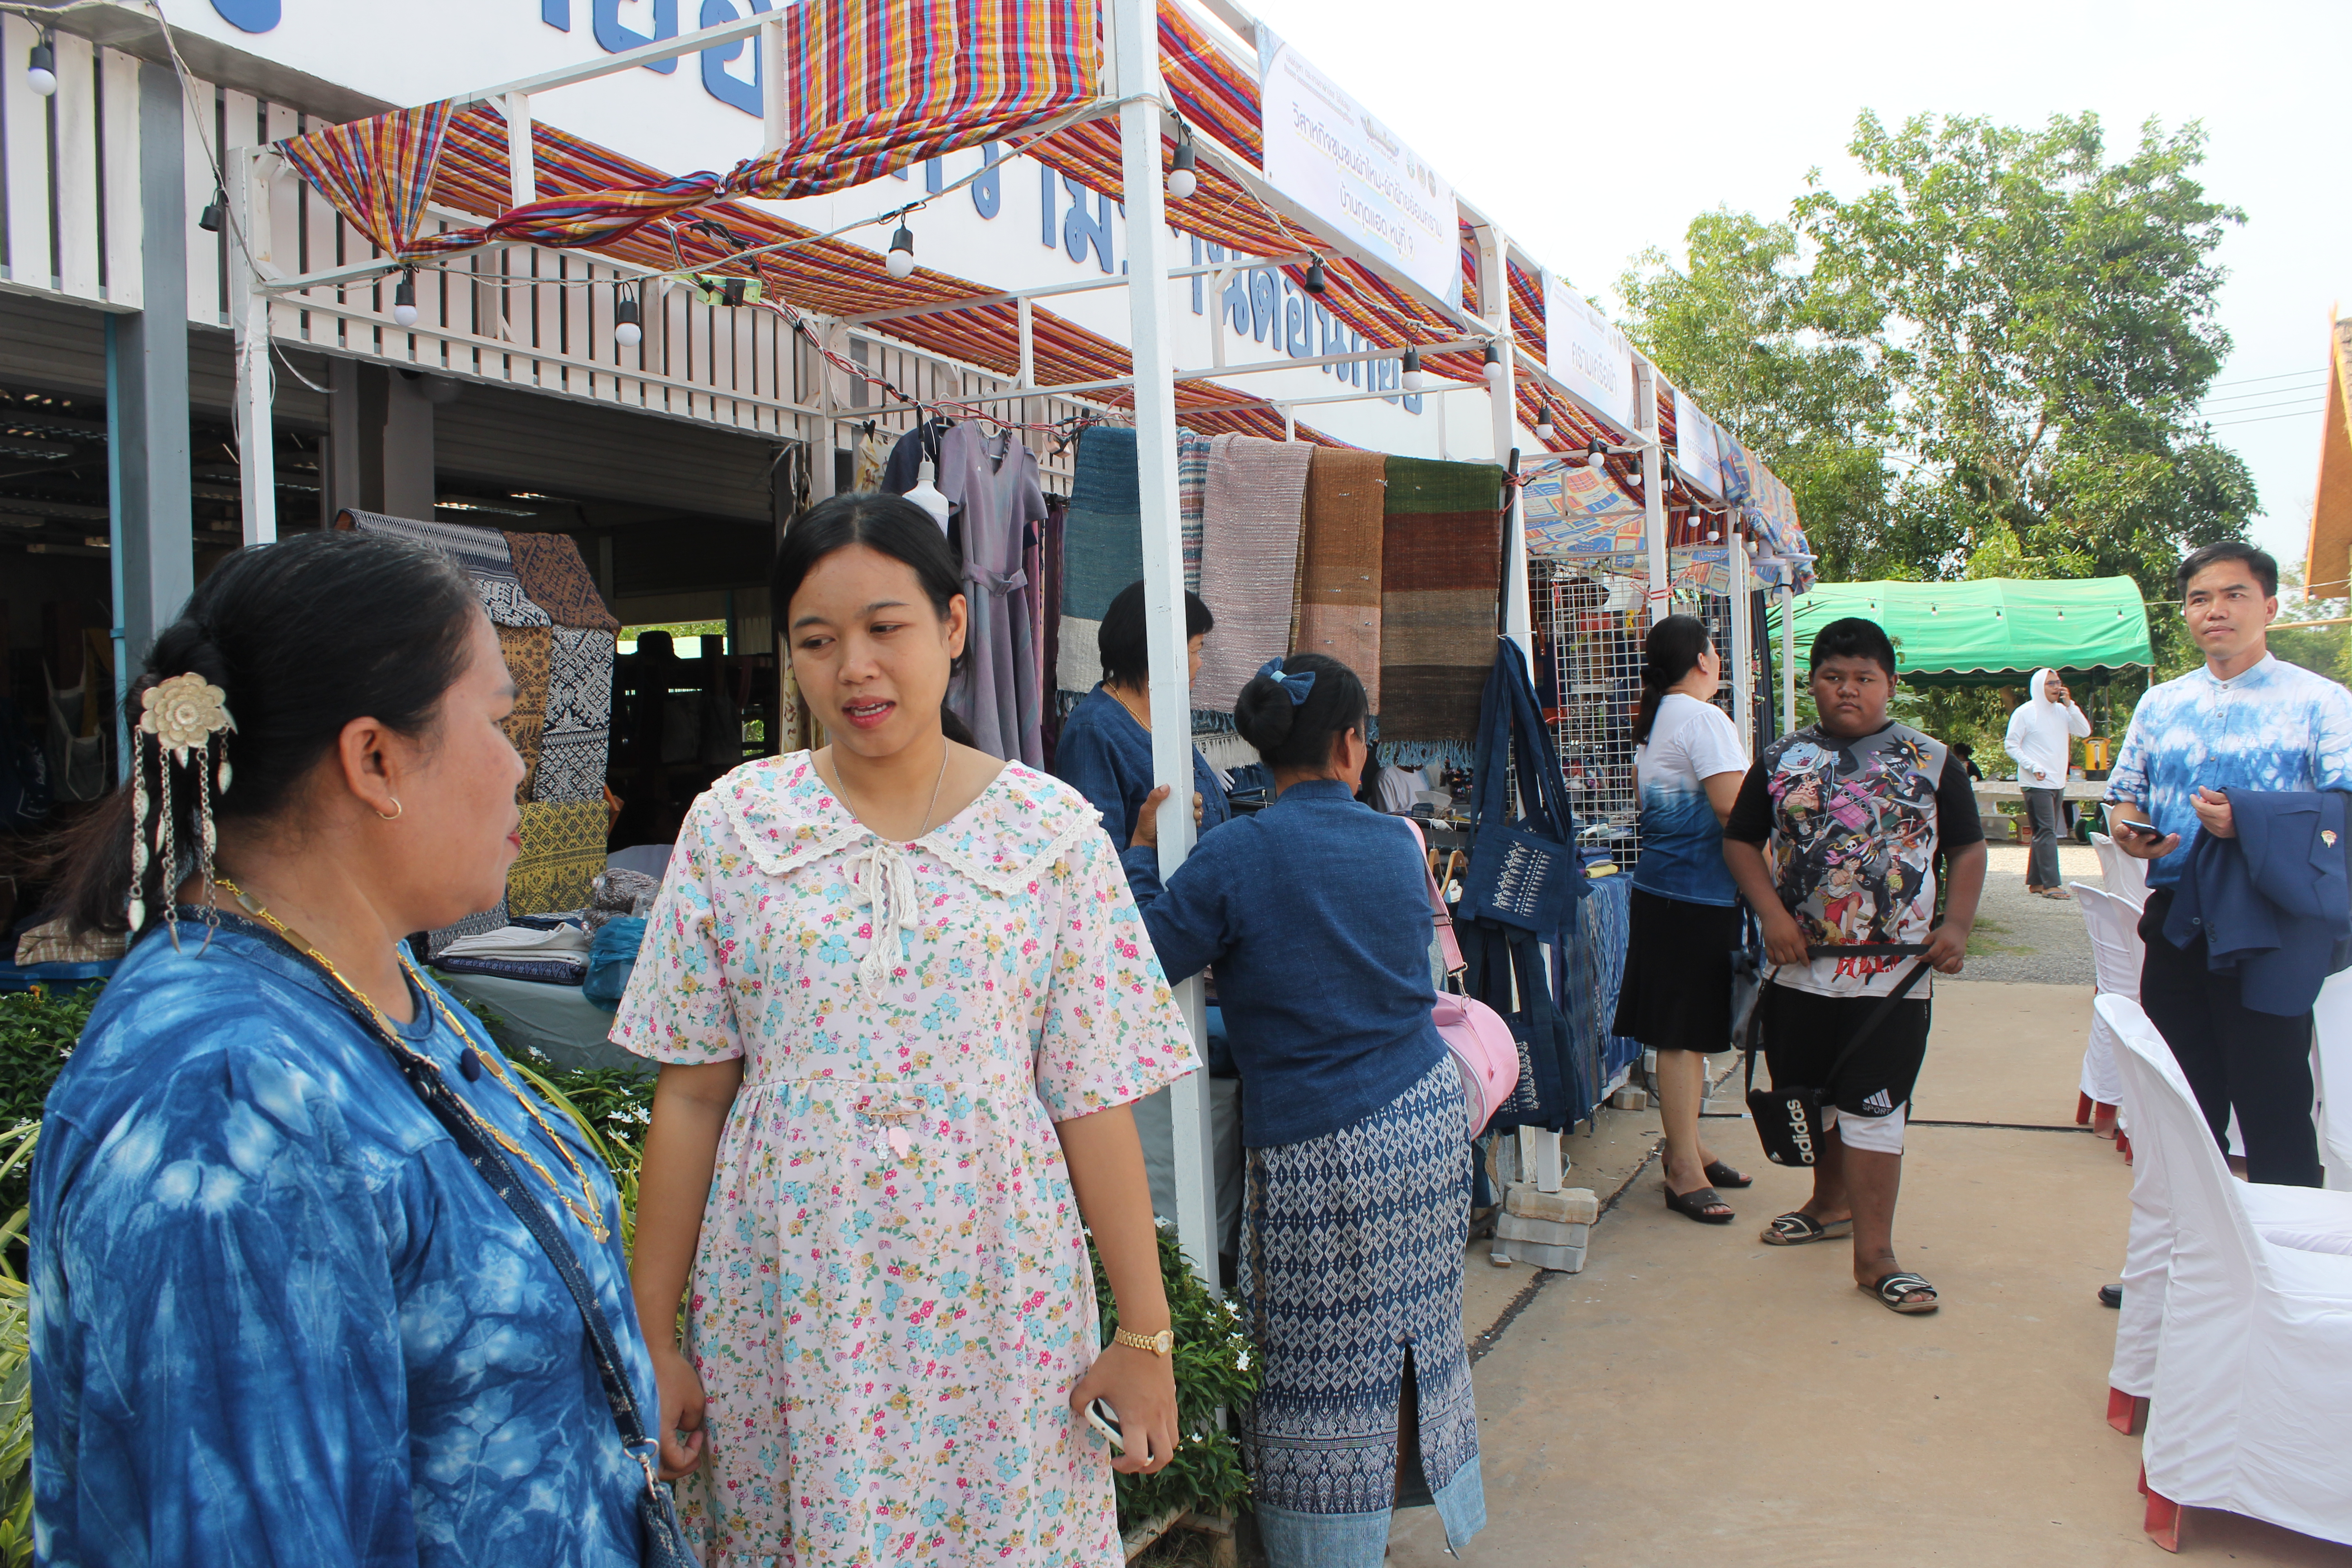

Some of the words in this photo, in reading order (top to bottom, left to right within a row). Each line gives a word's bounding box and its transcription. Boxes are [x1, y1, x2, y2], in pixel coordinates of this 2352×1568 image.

[1390, 216, 1406, 255] หมู่ที่
[1862, 1103, 1892, 1115] SPORT
[1787, 1099, 1815, 1164] adidas
